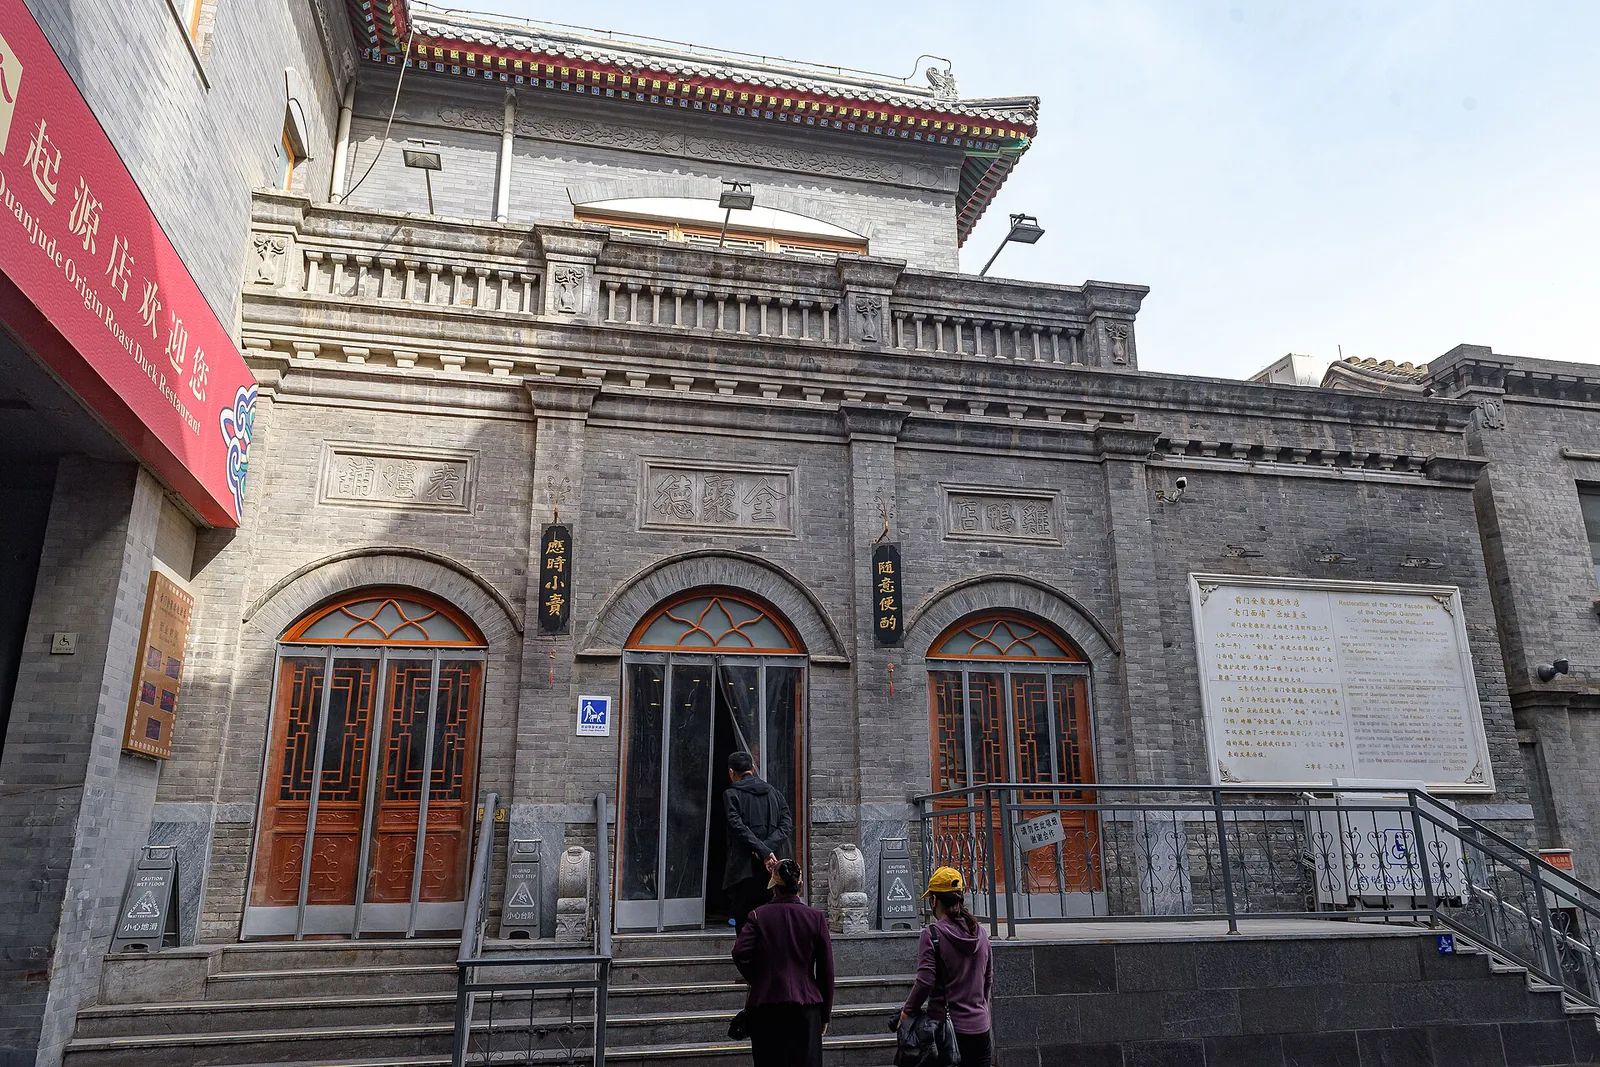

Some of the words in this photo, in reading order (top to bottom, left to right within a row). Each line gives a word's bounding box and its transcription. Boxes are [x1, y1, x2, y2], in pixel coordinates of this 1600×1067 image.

[64, 255, 104, 324] Origin
[105, 304, 135, 361] Roast
[135, 340, 159, 385] Duck
[158, 369, 202, 437] Restaurant
[1020, 816, 1058, 836] 请勿在此吸烟
[1030, 829, 1055, 844] 谢谢合作
[507, 911, 535, 920] 小心台阶
[124, 922, 158, 932] 小心地滑
